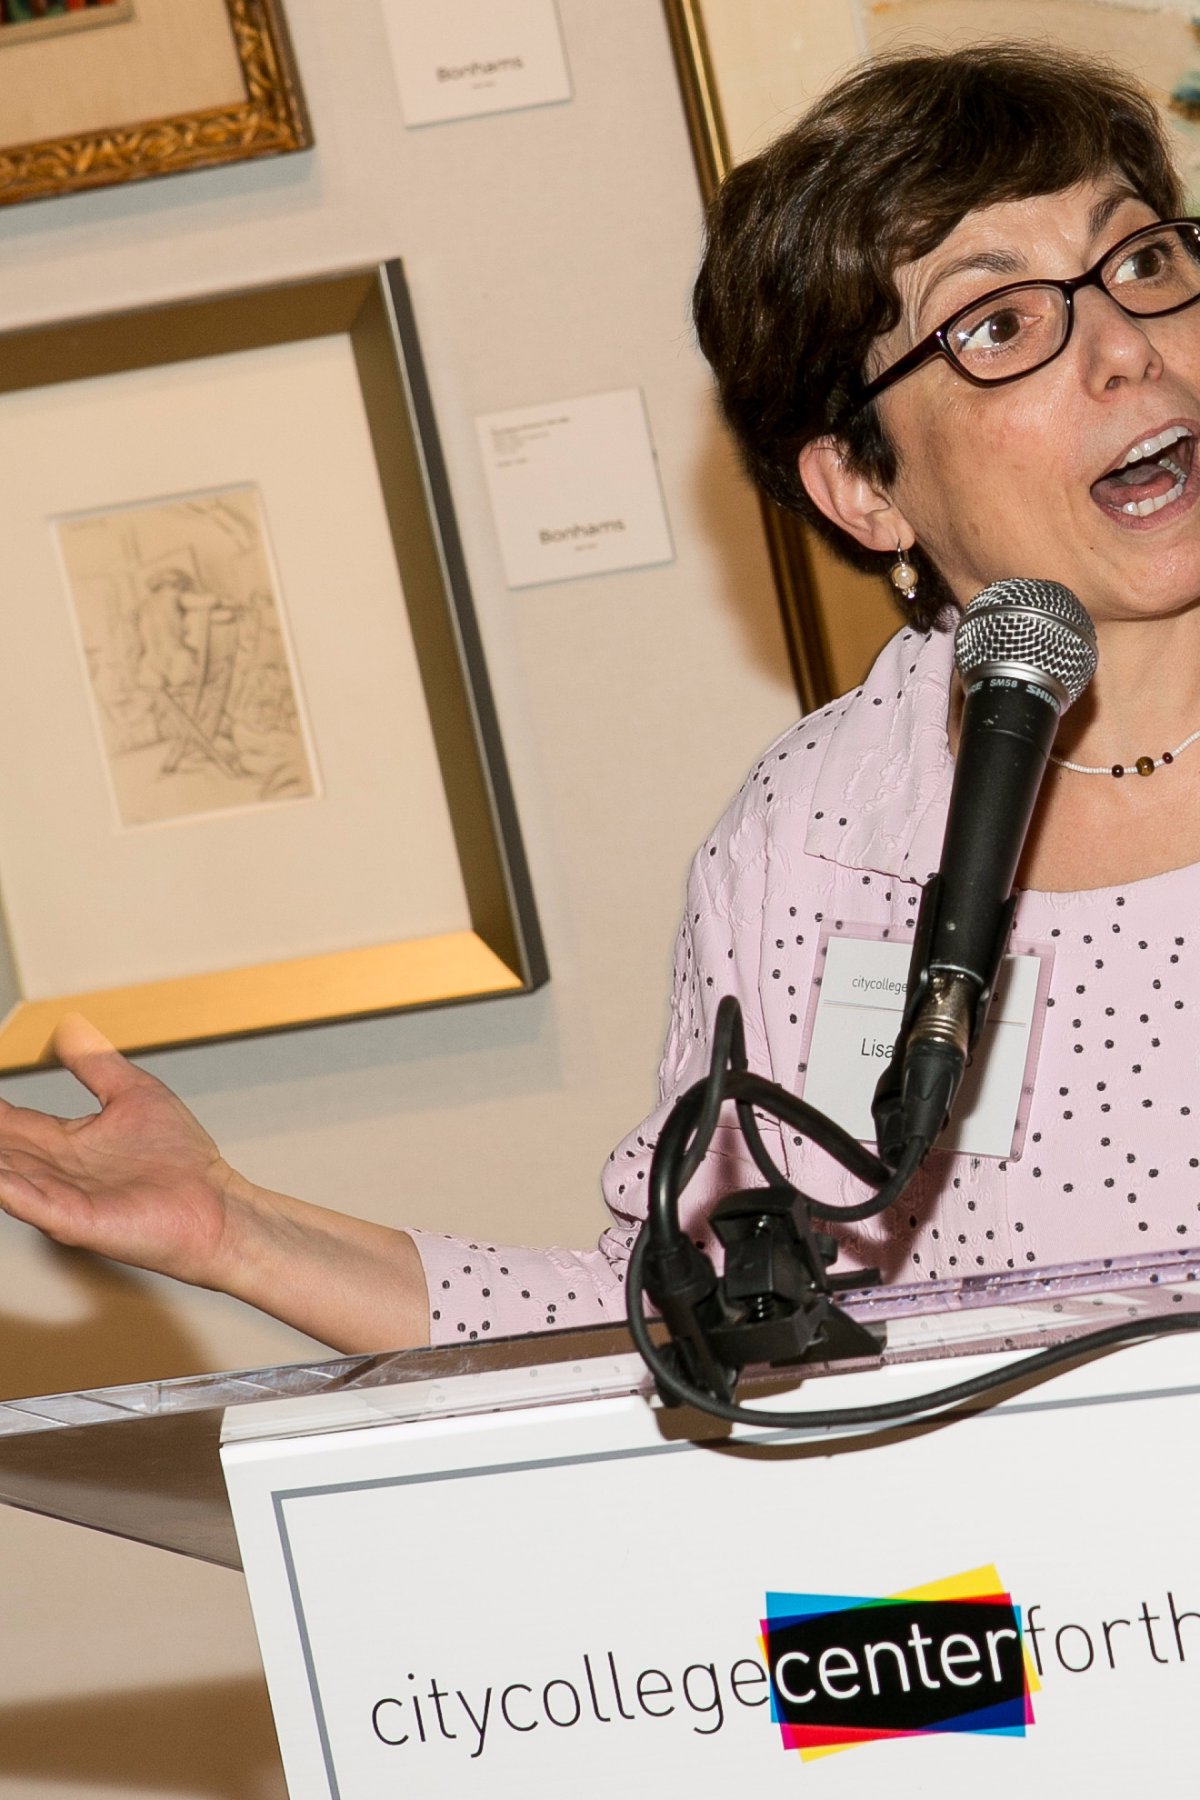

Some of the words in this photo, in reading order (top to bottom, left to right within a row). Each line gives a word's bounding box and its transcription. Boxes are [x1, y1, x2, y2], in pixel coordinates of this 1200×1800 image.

[436, 56, 523, 83] Bonhams
[539, 517, 626, 545] Bonhams
[990, 678, 1018, 689] SM58
[861, 1038, 895, 1059] Lisa
